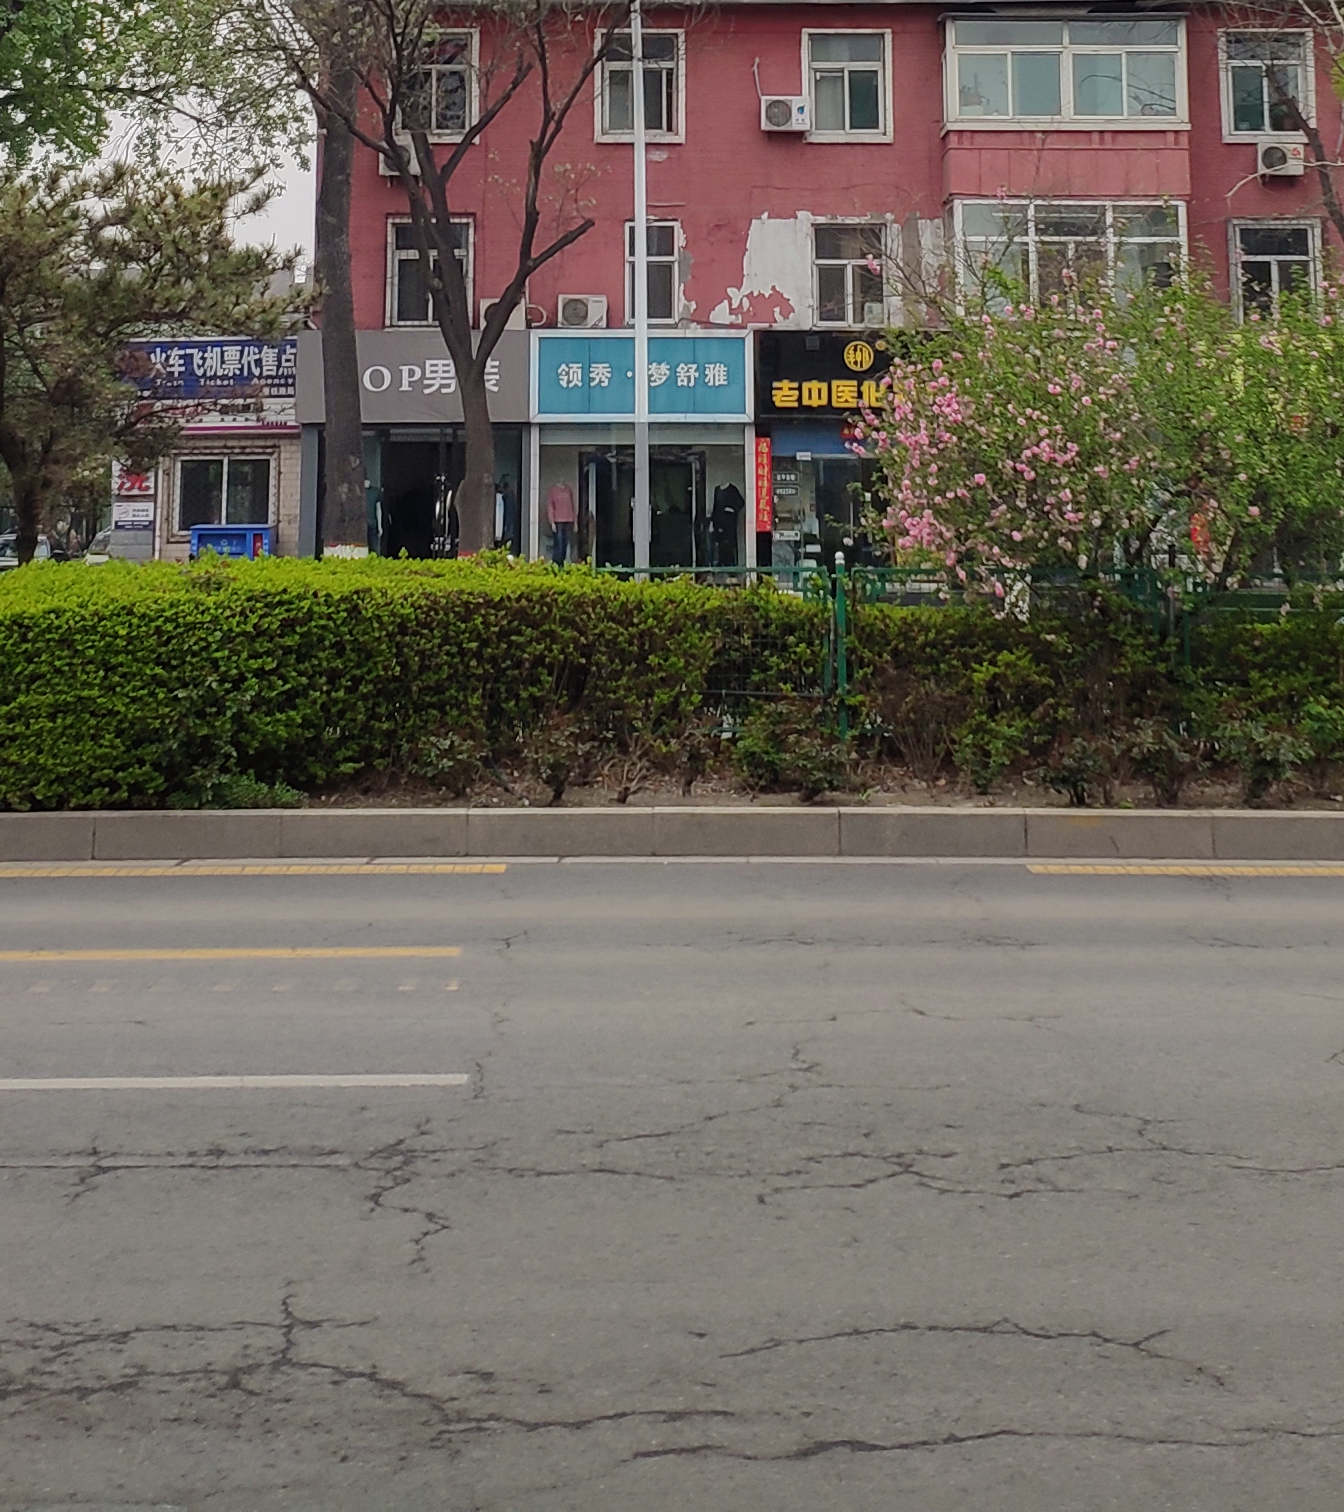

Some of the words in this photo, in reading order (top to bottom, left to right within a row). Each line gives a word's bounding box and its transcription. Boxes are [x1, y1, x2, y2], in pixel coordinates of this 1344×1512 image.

[151, 345, 297, 377] 火车飞机票代售点
[557, 362, 729, 388] 领秀·梦舒雅
[771, 379, 904, 408] 老中医化
